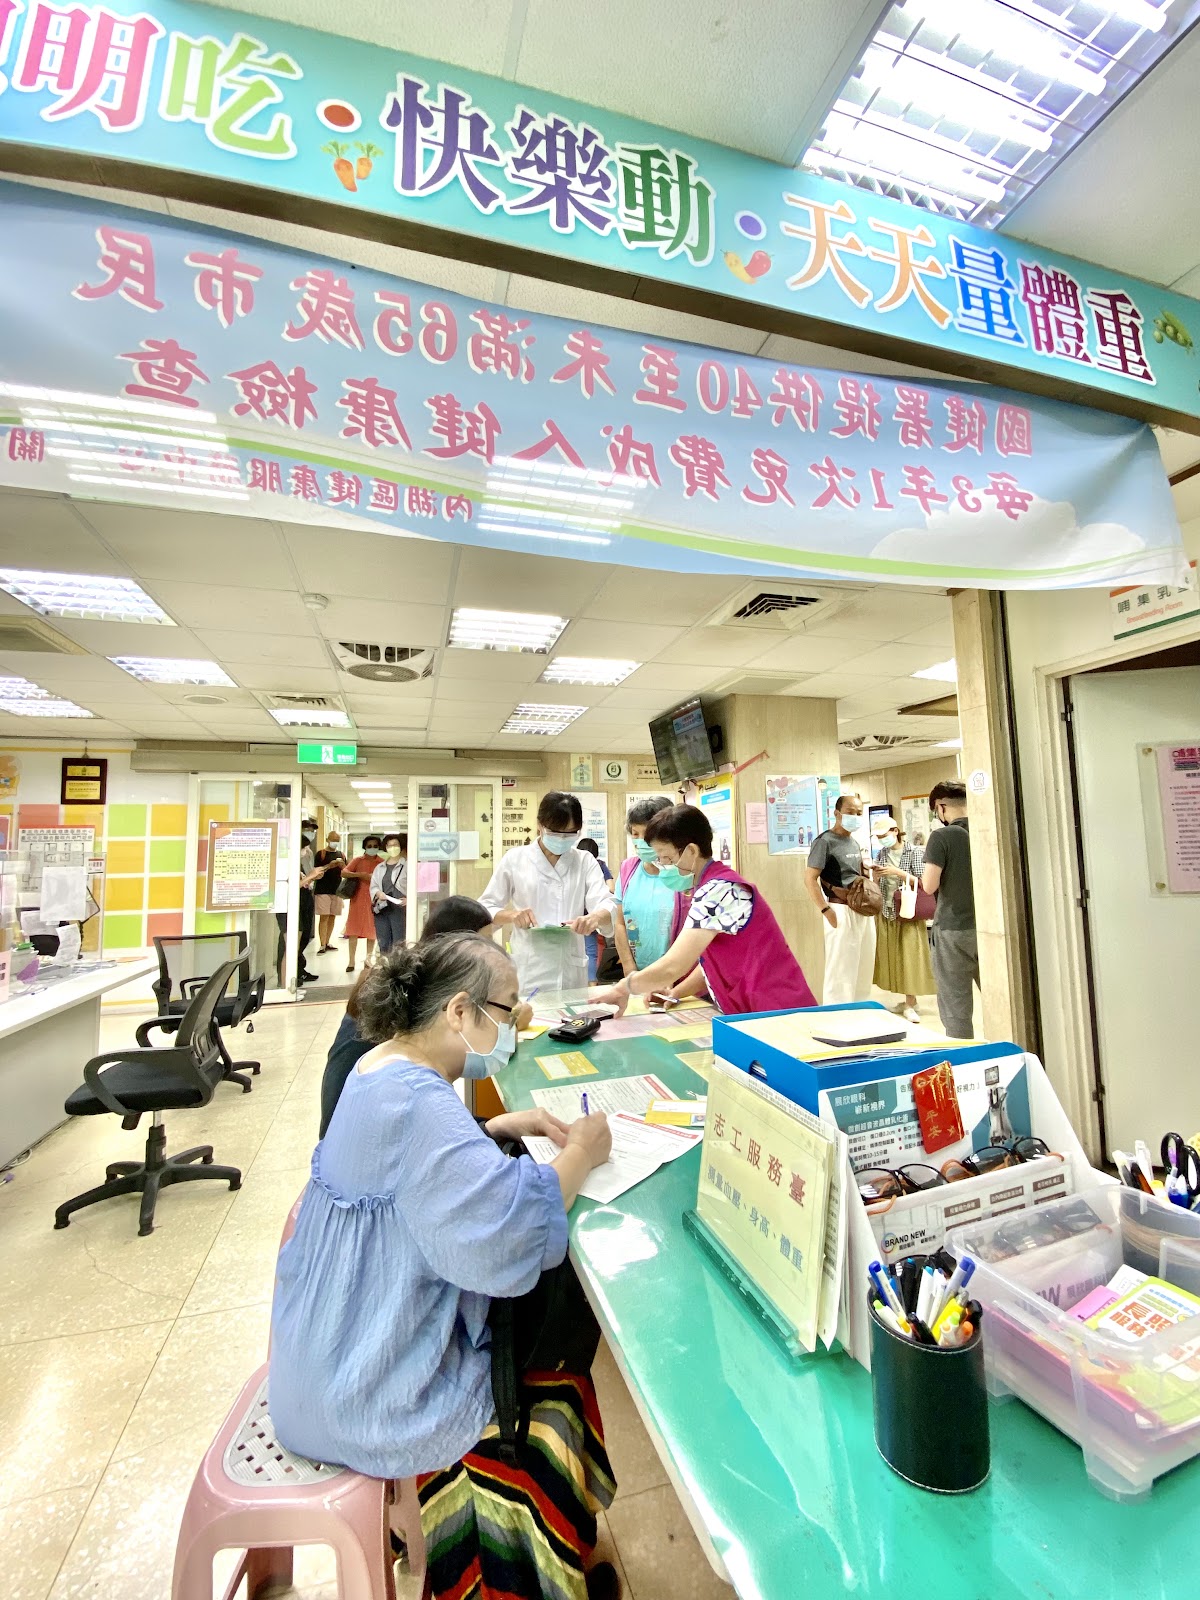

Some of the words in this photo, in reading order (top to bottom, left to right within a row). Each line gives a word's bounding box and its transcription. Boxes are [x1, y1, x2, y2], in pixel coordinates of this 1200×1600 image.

[712, 1112, 807, 1208] 志工服務臺
[884, 1234, 909, 1248] BRAND
[910, 1229, 927, 1240] NEW
